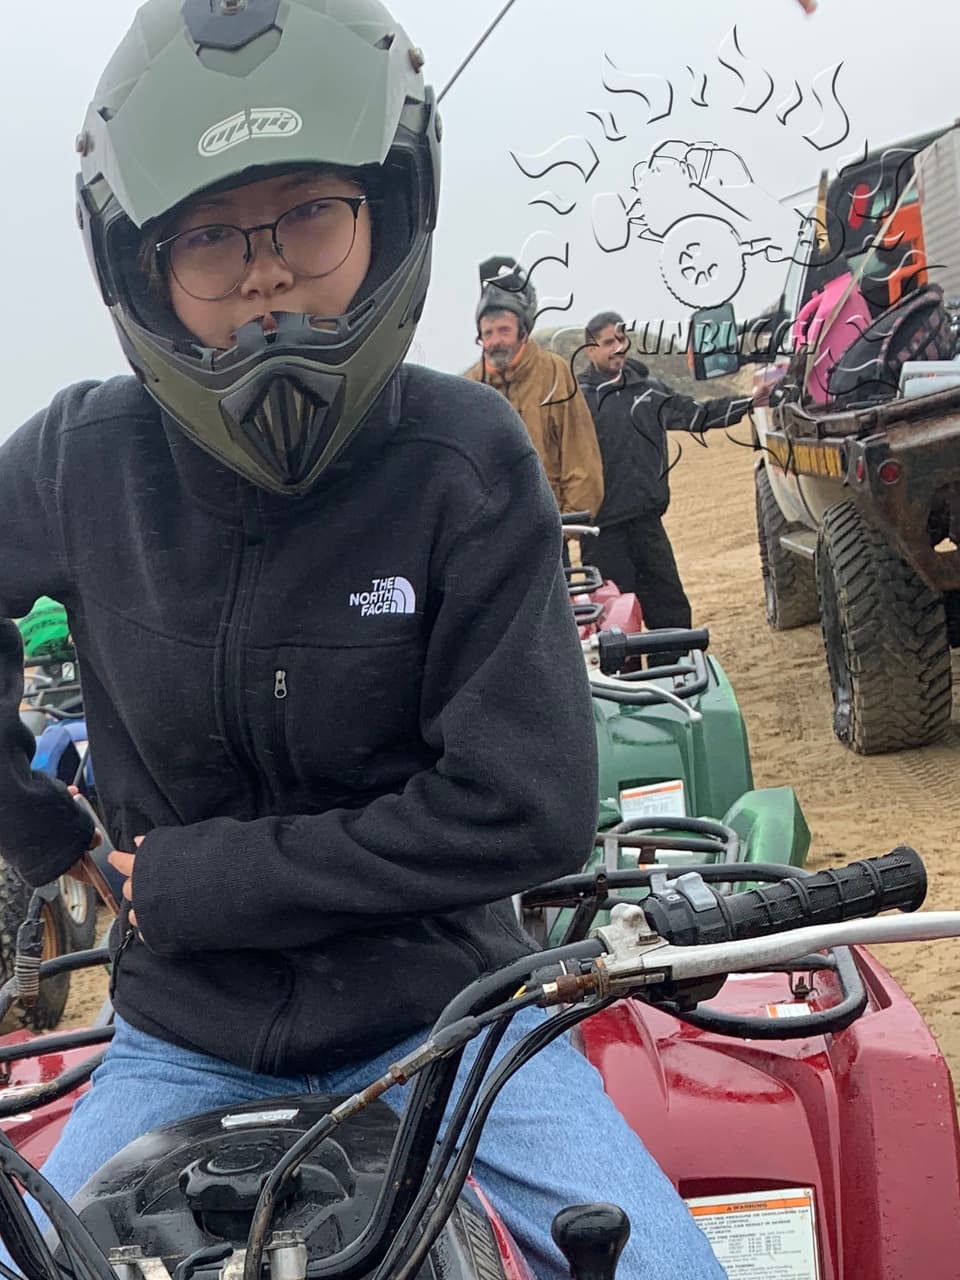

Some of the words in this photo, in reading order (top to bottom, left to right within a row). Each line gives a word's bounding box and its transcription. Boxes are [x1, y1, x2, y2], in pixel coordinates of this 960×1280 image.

[372, 576, 395, 592] THE
[349, 588, 393, 606] NORTH
[360, 600, 391, 617] FACE
